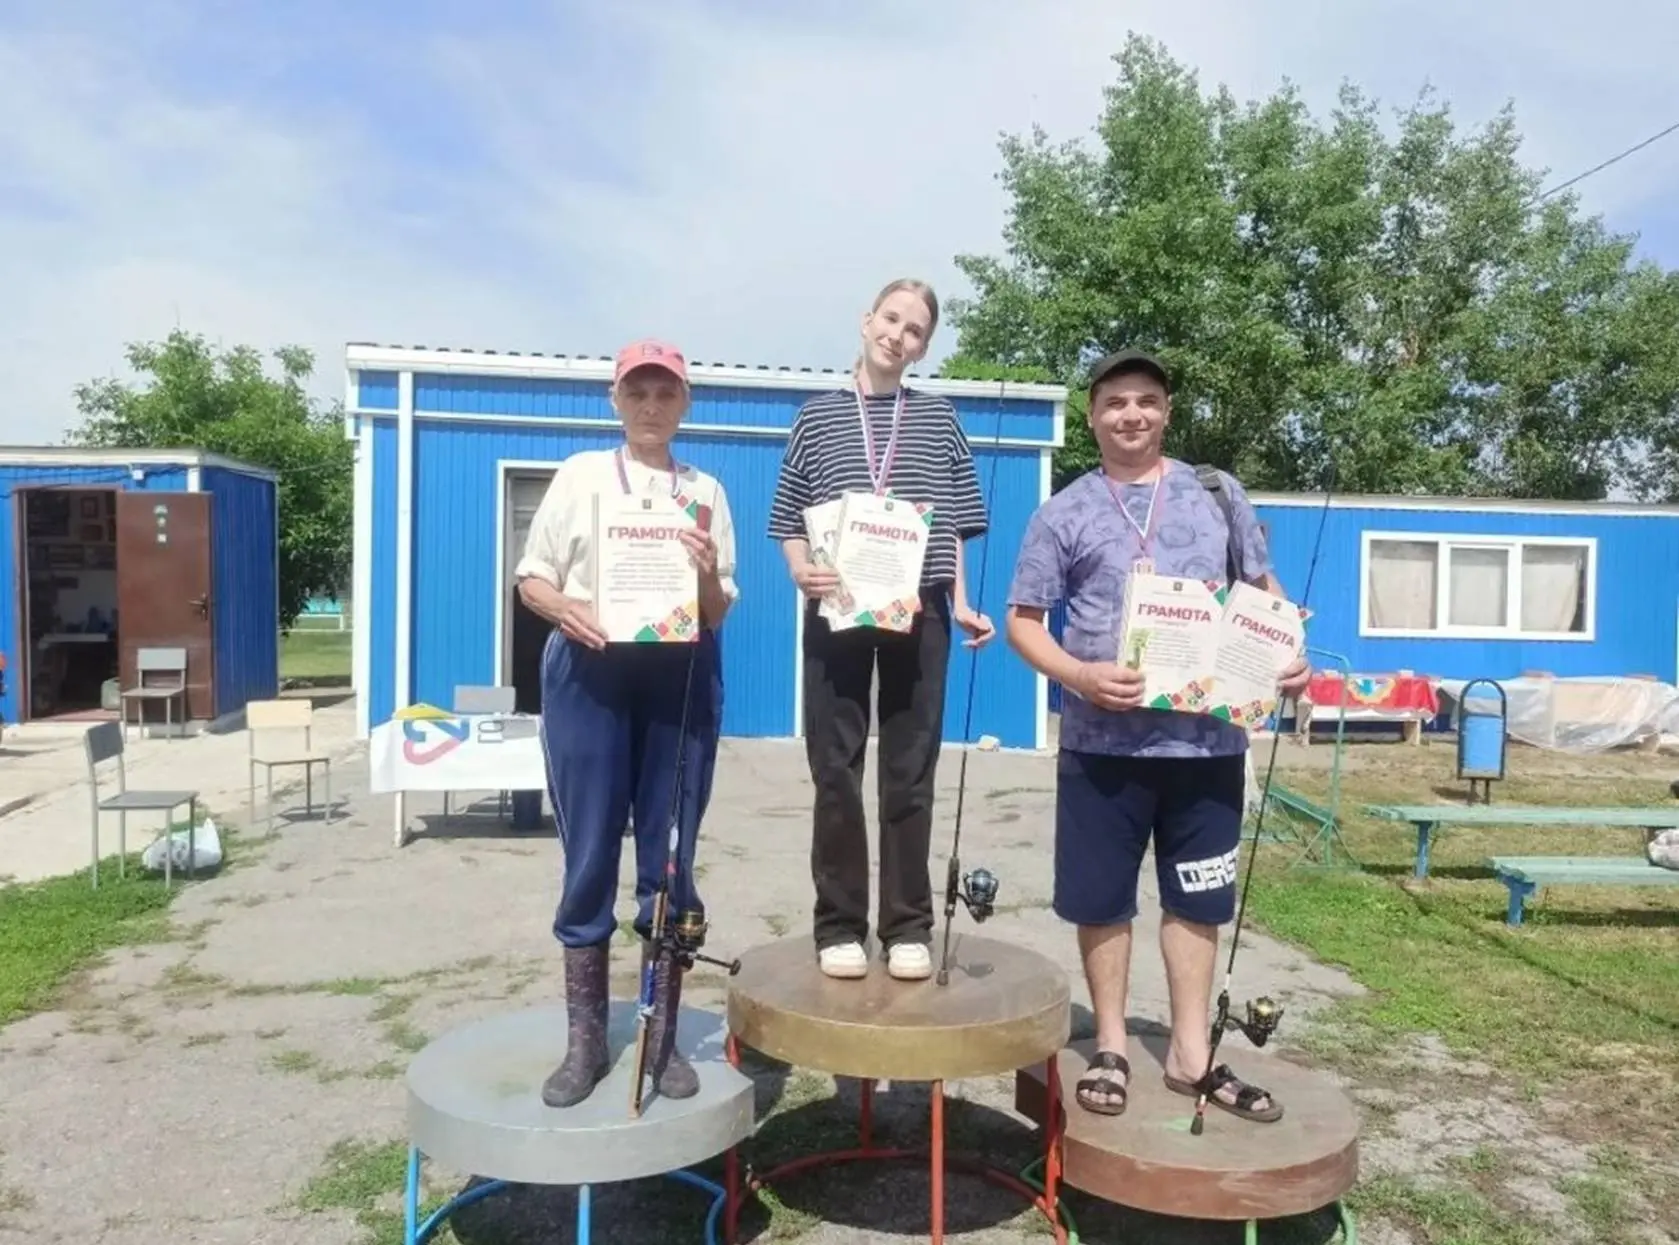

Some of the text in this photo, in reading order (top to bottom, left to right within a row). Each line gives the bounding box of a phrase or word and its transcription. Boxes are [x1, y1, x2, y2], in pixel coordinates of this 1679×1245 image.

[850, 520, 919, 543] ГРАМОТА
[1138, 603, 1212, 622] ГРАМОТА
[1232, 613, 1295, 647] ГРАМОТА
